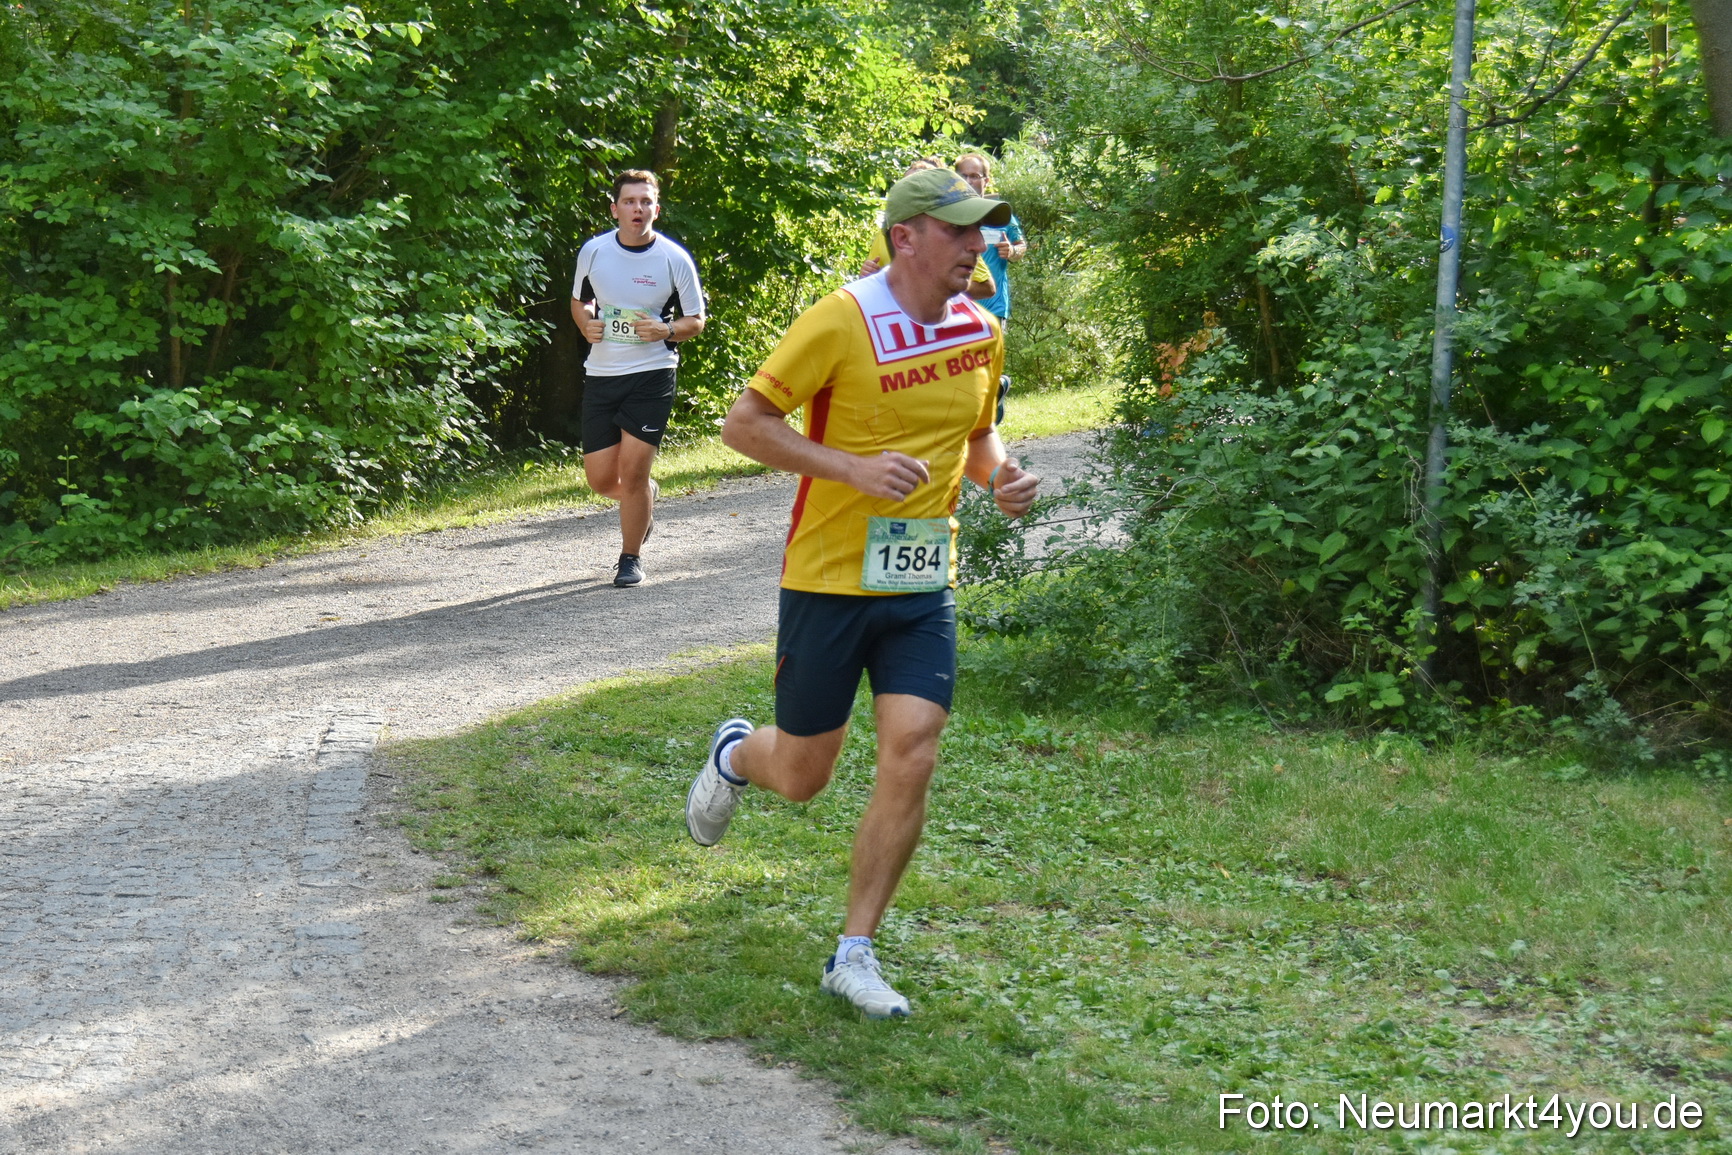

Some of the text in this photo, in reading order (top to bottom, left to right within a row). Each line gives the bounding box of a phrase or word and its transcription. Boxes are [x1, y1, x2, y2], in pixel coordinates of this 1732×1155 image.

[880, 363, 941, 393] MAX
[878, 544, 941, 571] 1584
[908, 572, 933, 580] Thomas
